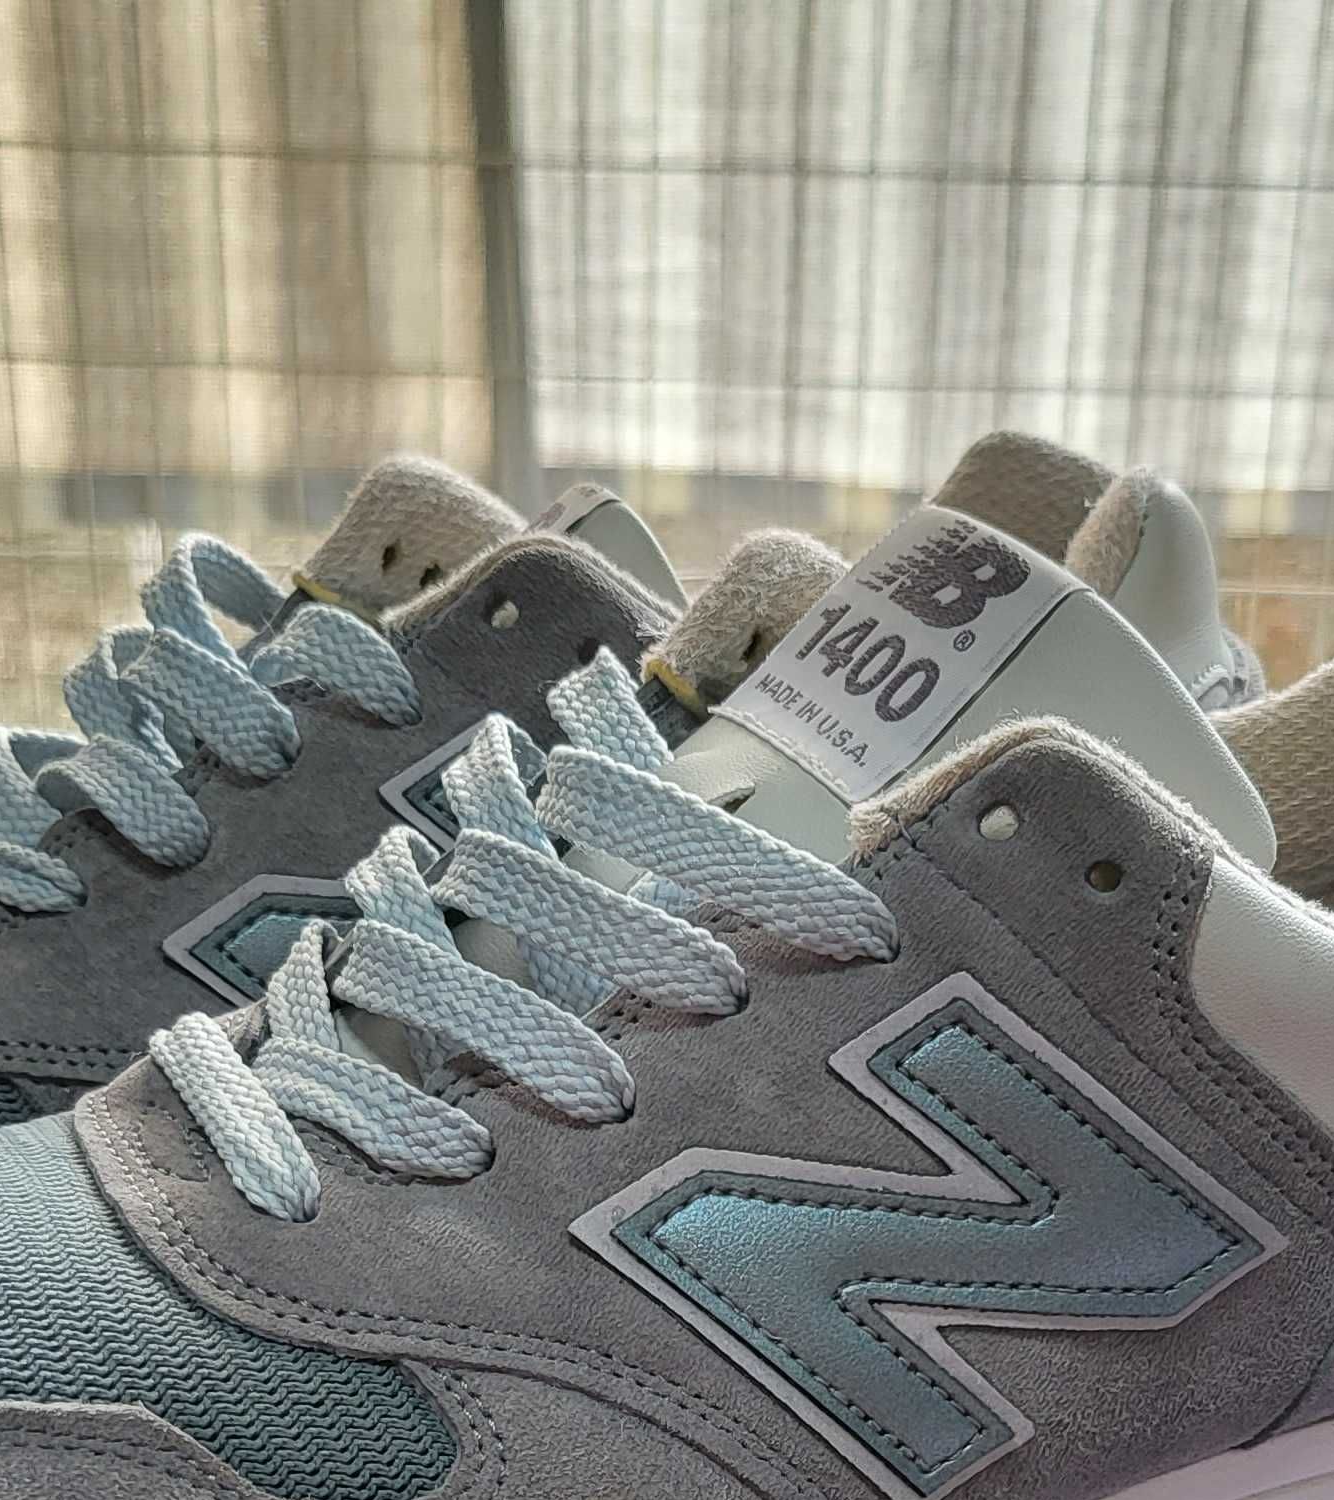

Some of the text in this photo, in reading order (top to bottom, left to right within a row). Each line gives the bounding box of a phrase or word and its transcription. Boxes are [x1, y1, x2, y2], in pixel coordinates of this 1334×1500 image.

[795, 603, 940, 722] 1400
[755, 673, 869, 767] MADE IN U.S.A.
